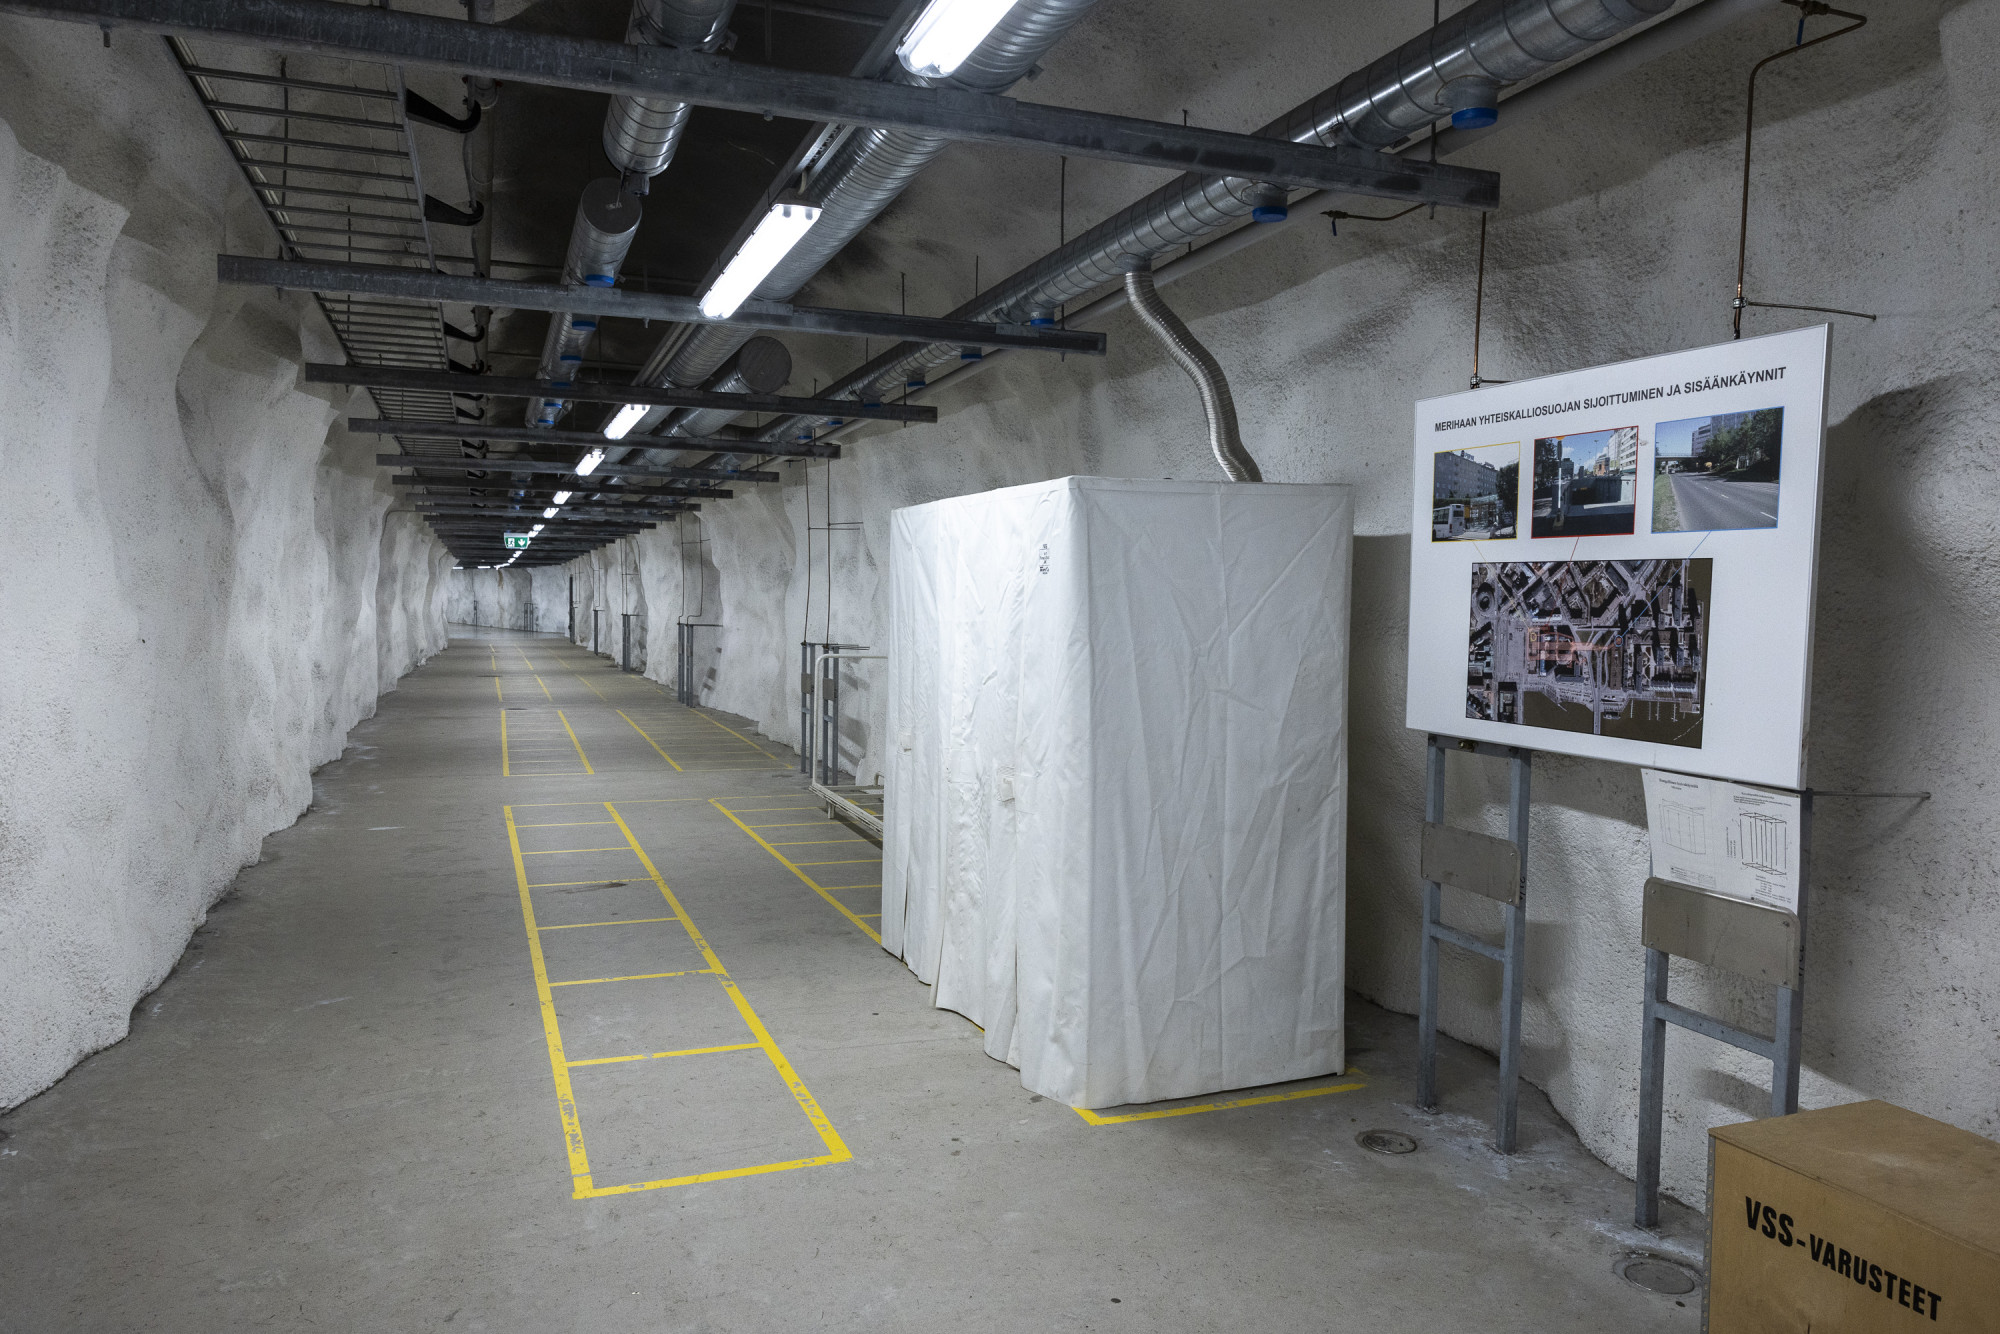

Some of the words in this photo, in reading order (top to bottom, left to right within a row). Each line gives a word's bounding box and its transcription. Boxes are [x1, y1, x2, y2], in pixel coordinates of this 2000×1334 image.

[1434, 417, 1477, 432] MERIHAAN
[1479, 400, 1581, 425] YHTEISKALLIOSUOJAN
[1583, 387, 1664, 409] SIJOITTUMINEN
[1666, 384, 1681, 397] JA
[1684, 366, 1787, 394] SISÄÄNKÄYNNIT
[1745, 1195, 1942, 1321] VSS-VARUSTEET
